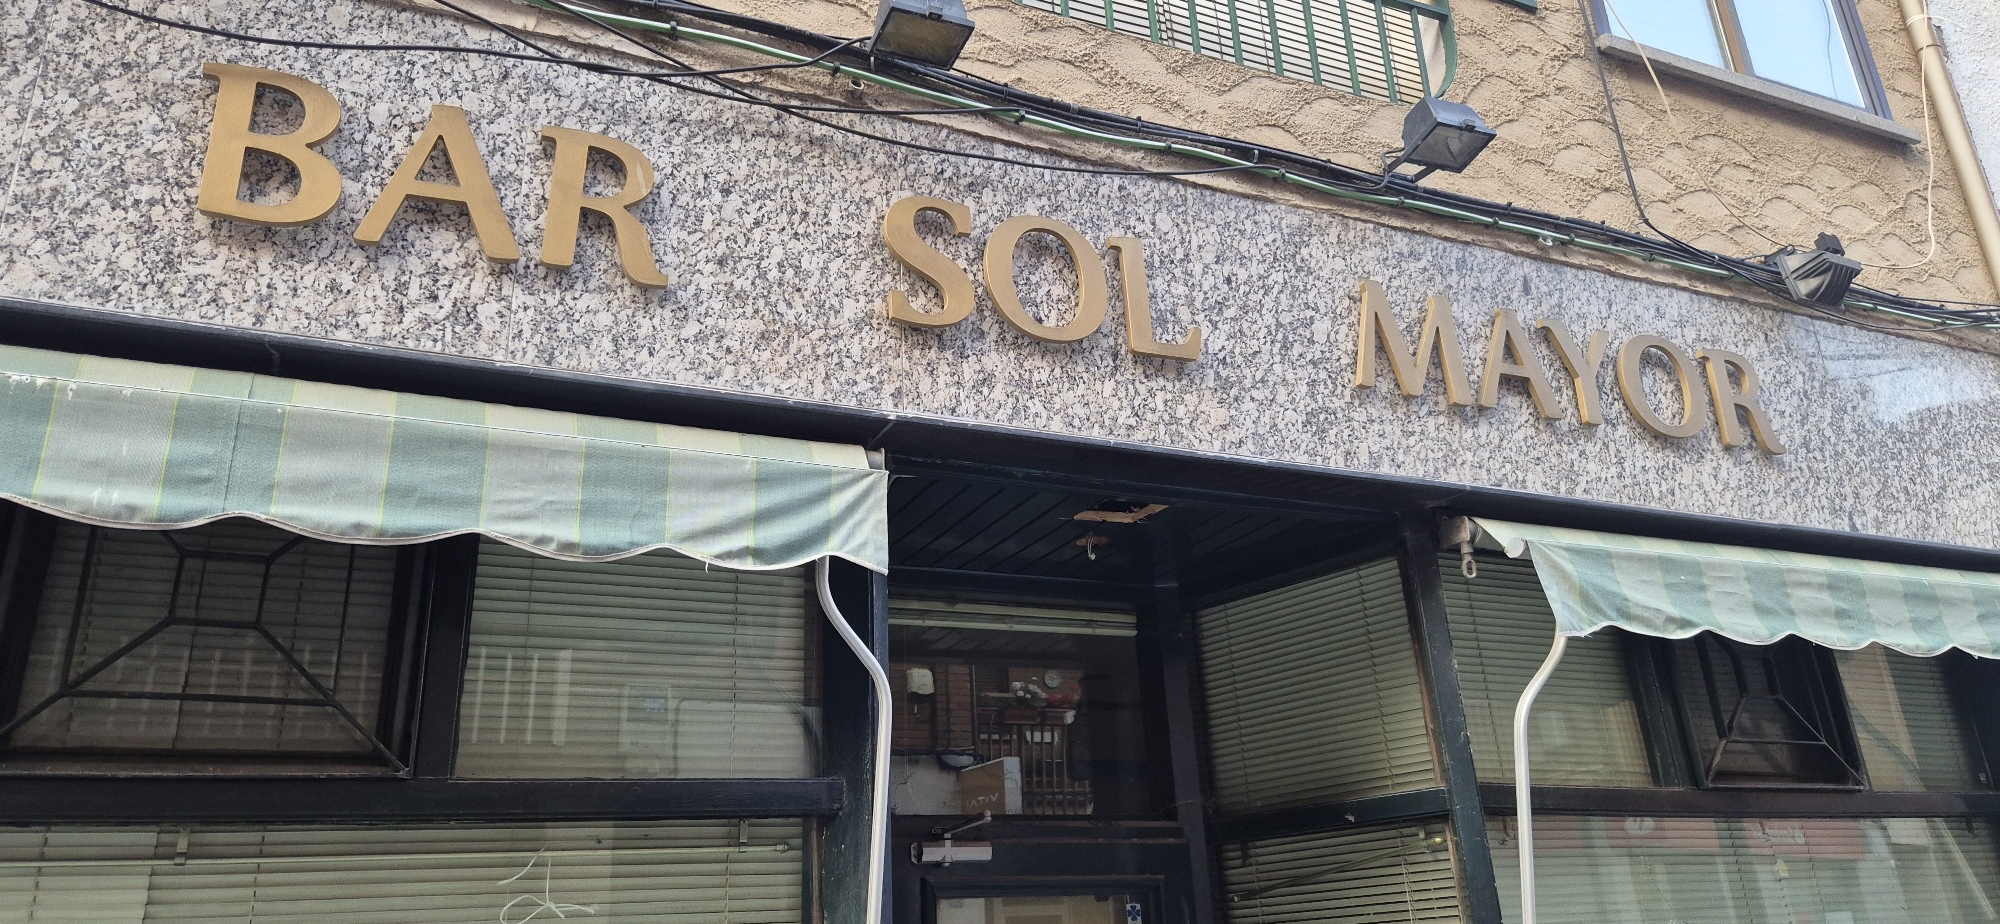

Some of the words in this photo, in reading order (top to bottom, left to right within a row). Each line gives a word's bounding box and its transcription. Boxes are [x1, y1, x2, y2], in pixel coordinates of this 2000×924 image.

[198, 62, 669, 290] BAR
[883, 196, 1202, 361] SOL
[1355, 279, 1786, 455] MAYOR
